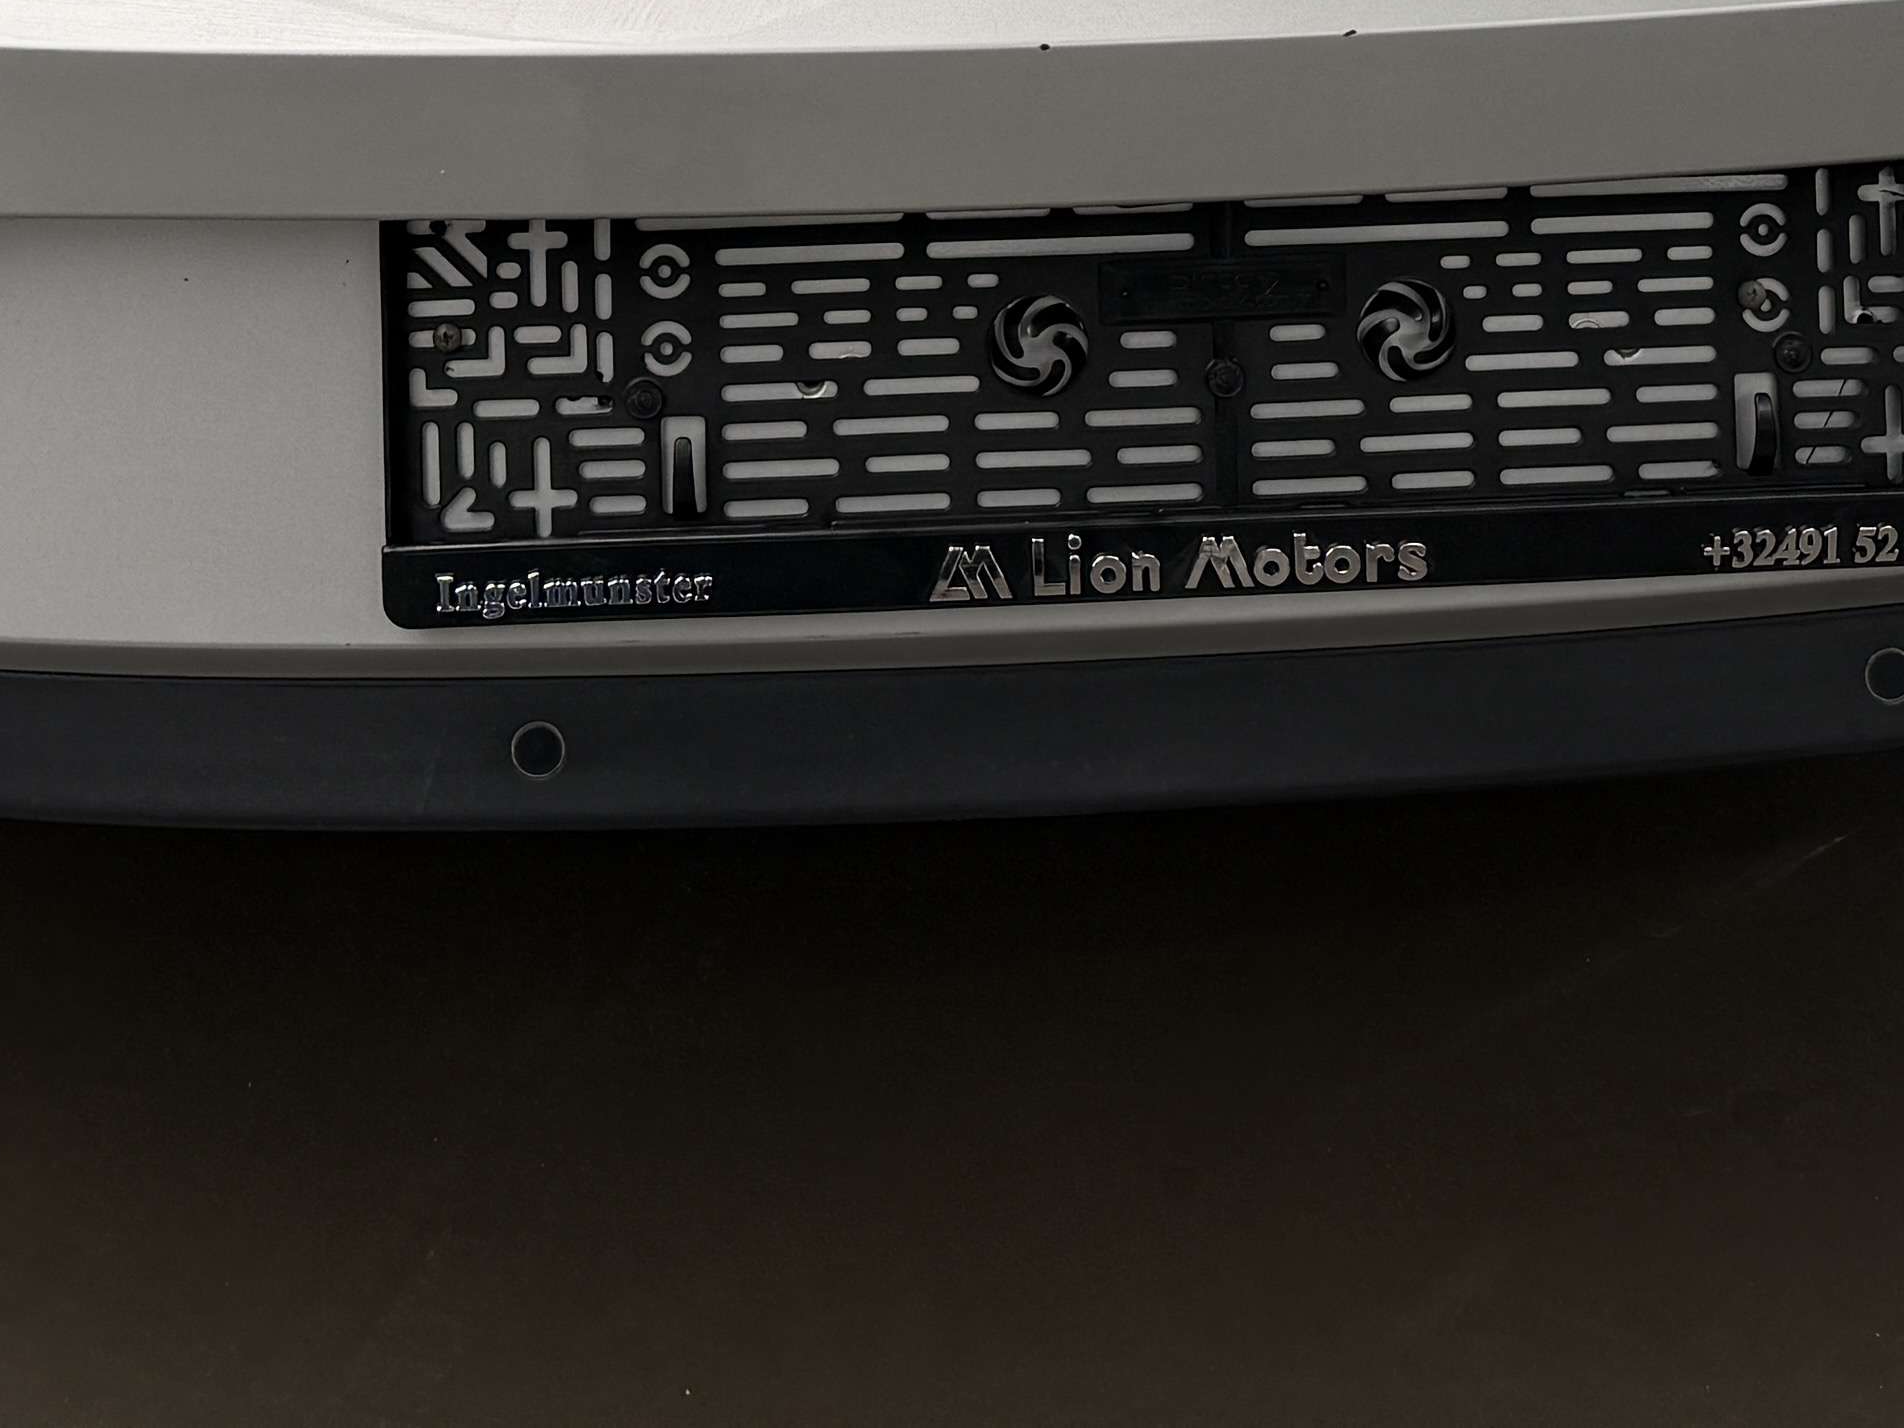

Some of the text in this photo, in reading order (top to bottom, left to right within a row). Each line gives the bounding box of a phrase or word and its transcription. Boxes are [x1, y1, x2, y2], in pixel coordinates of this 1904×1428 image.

[1031, 533, 1161, 596] Lion
[1185, 532, 1429, 590] Motors
[1703, 526, 1841, 568] +32491
[1854, 525, 1900, 563] 52
[435, 568, 713, 619] Ingelmunster
